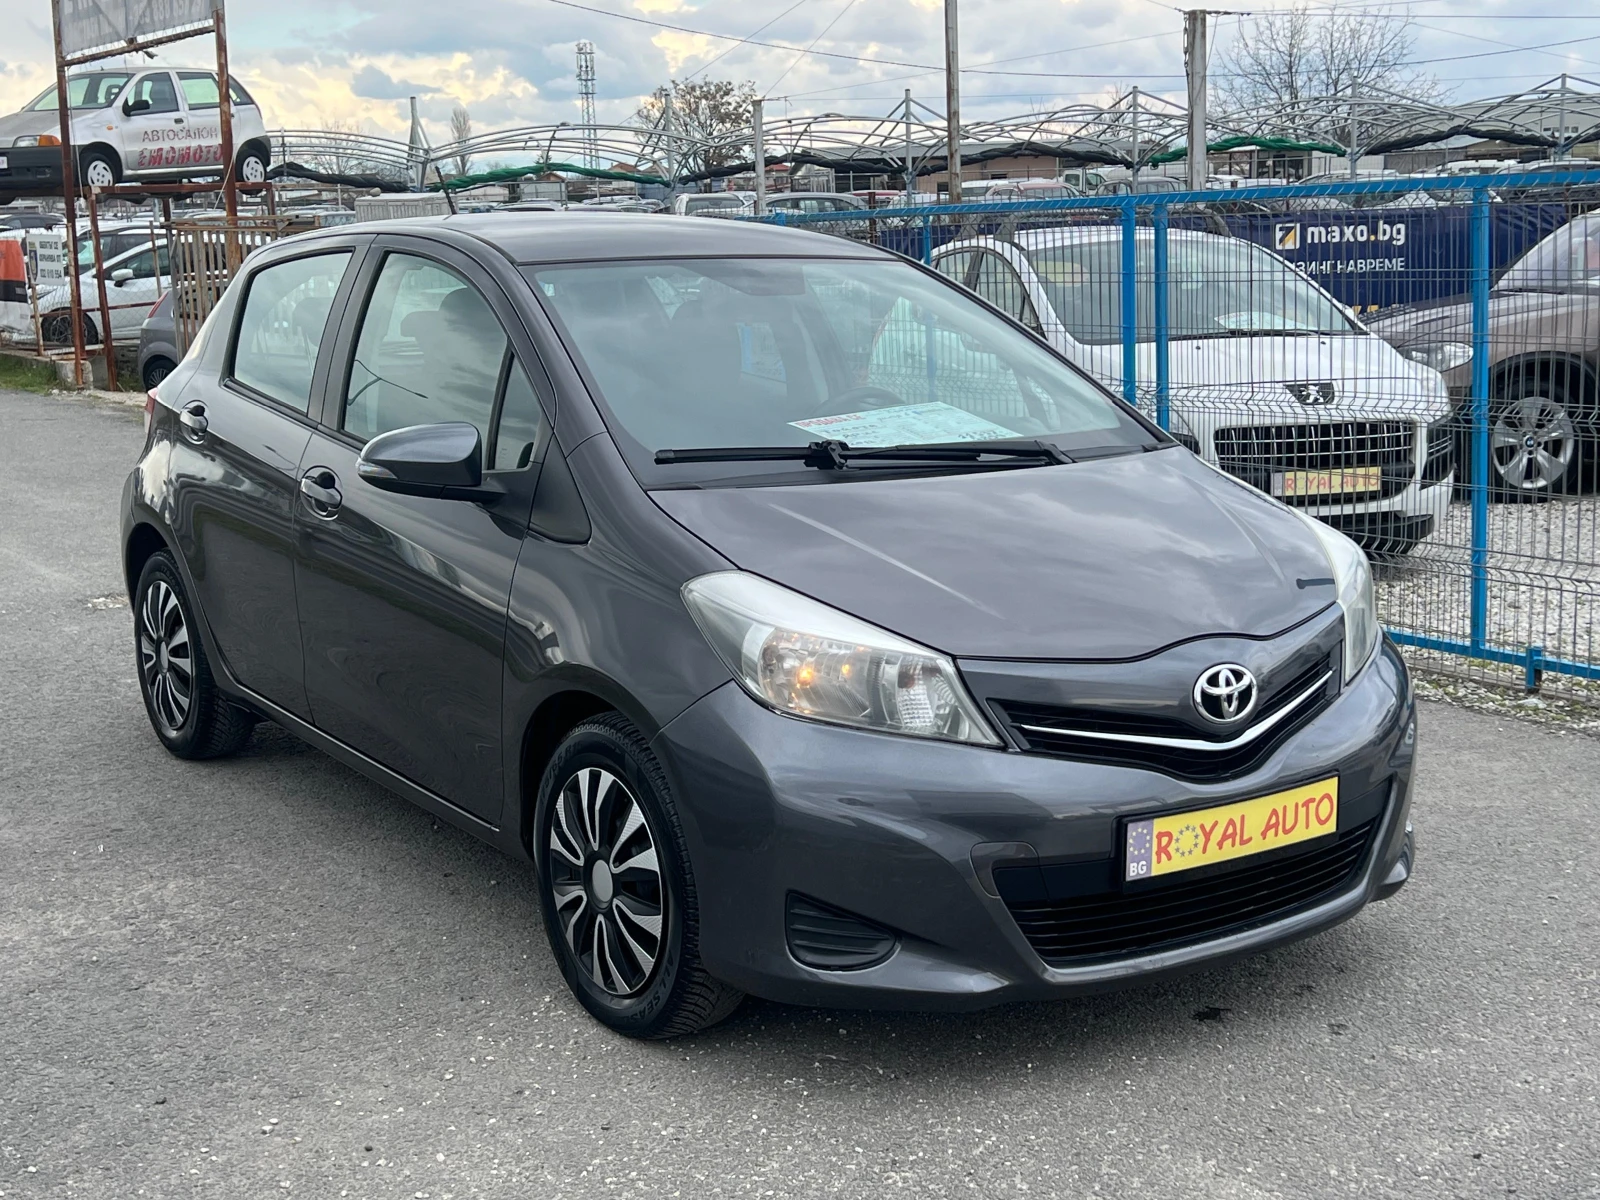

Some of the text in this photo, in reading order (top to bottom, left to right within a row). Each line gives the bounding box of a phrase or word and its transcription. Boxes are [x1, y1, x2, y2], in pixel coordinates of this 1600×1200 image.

[142, 127, 218, 142] АВТОСАЛОН
[1307, 219, 1406, 246] maxo.bg
[1293, 257, 1405, 275] ЗИНГ НАВРЕМЕ
[1285, 472, 1379, 491] ROYAL AUTO
[1155, 792, 1335, 864] ROYAL AUTO
[1129, 860, 1147, 877] BG
